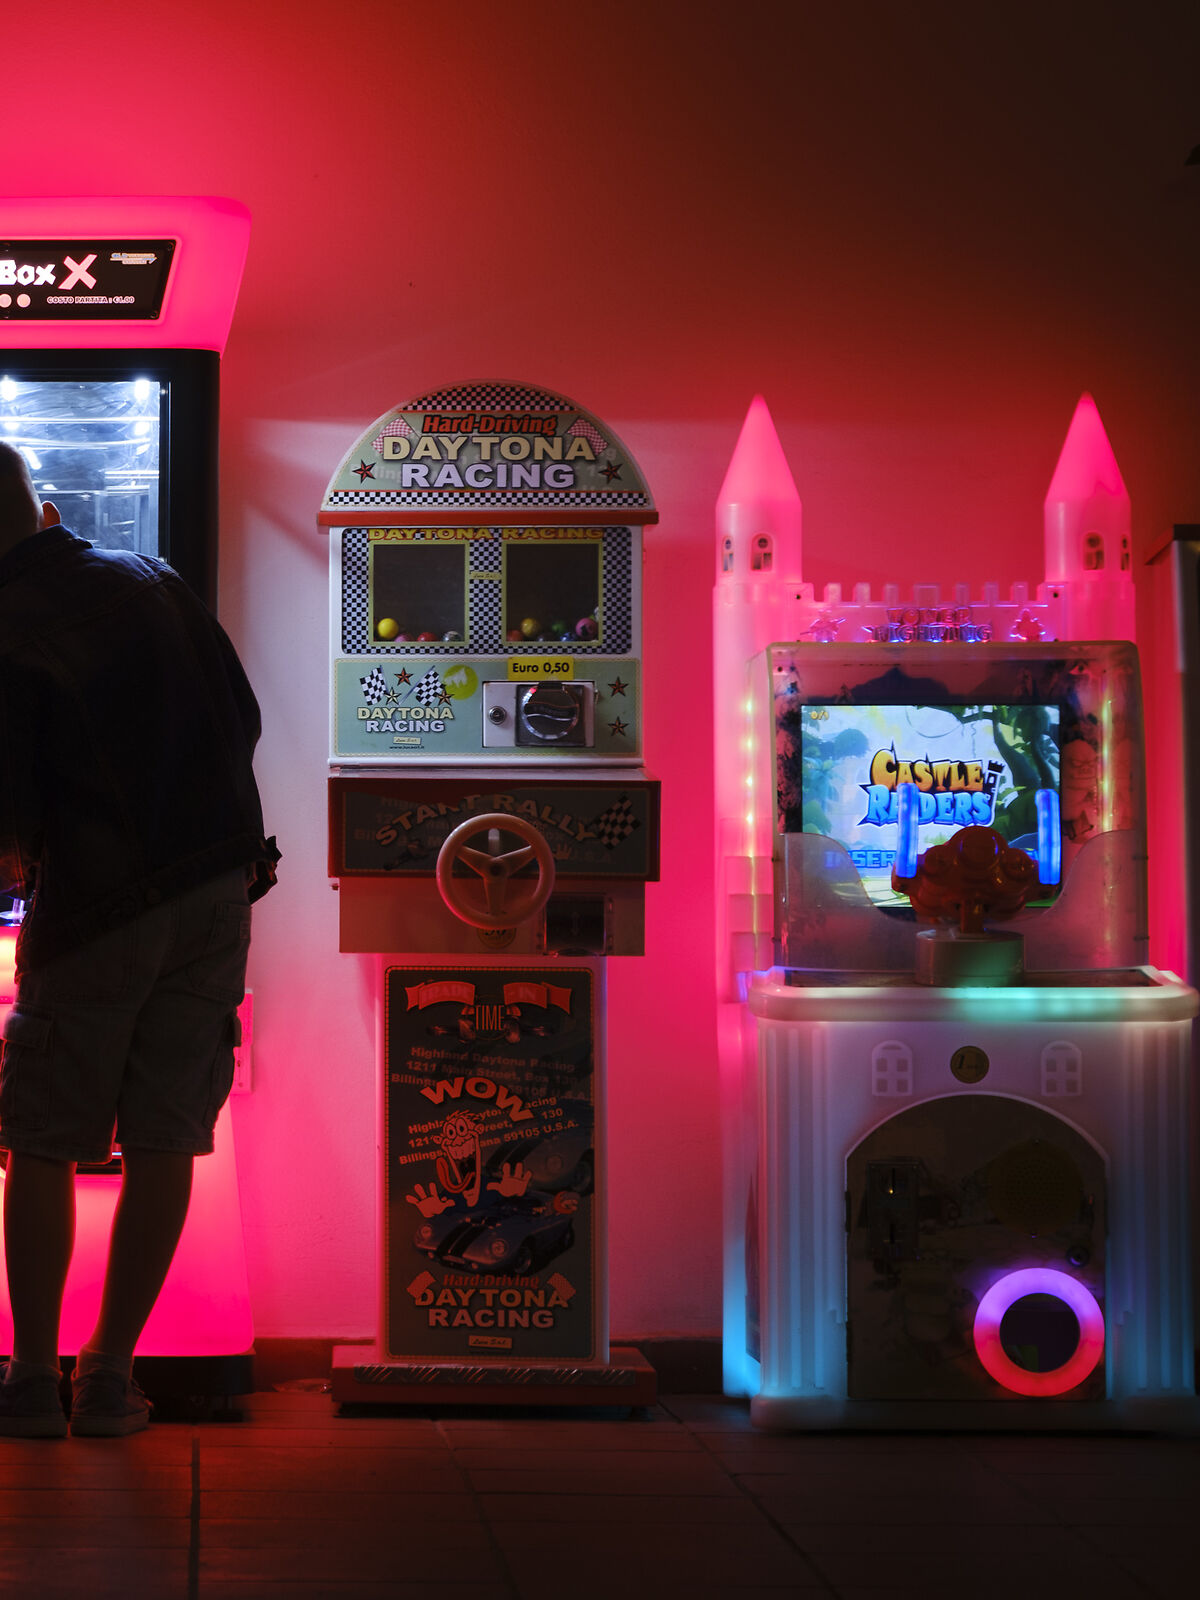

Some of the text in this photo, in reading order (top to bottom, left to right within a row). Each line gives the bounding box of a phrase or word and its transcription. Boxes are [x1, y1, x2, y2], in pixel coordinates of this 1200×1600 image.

[57, 253, 98, 291] X
[46, 296, 74, 304] COSTO
[422, 415, 557, 435] Hard-Driving
[382, 436, 596, 461] DAYTONA
[402, 463, 575, 488] RACING
[368, 528, 604, 540] DAYTONA RACING
[512, 662, 569, 675] Euro 0,50
[357, 707, 453, 719] DAYTONA
[366, 720, 445, 732] RACING
[870, 745, 985, 792] CASTLE
[866, 784, 993, 826] RDERS
[492, 794, 597, 841] RALLY
[475, 1005, 505, 1032] TIME
[472, 1053, 526, 1067] Daytona
[419, 1076, 536, 1123] WOW
[541, 1107, 564, 1121] 130
[442, 1274, 540, 1289] Hard-Driving
[415, 1287, 569, 1309] DAYTONA
[428, 1308, 555, 1329] RACING
